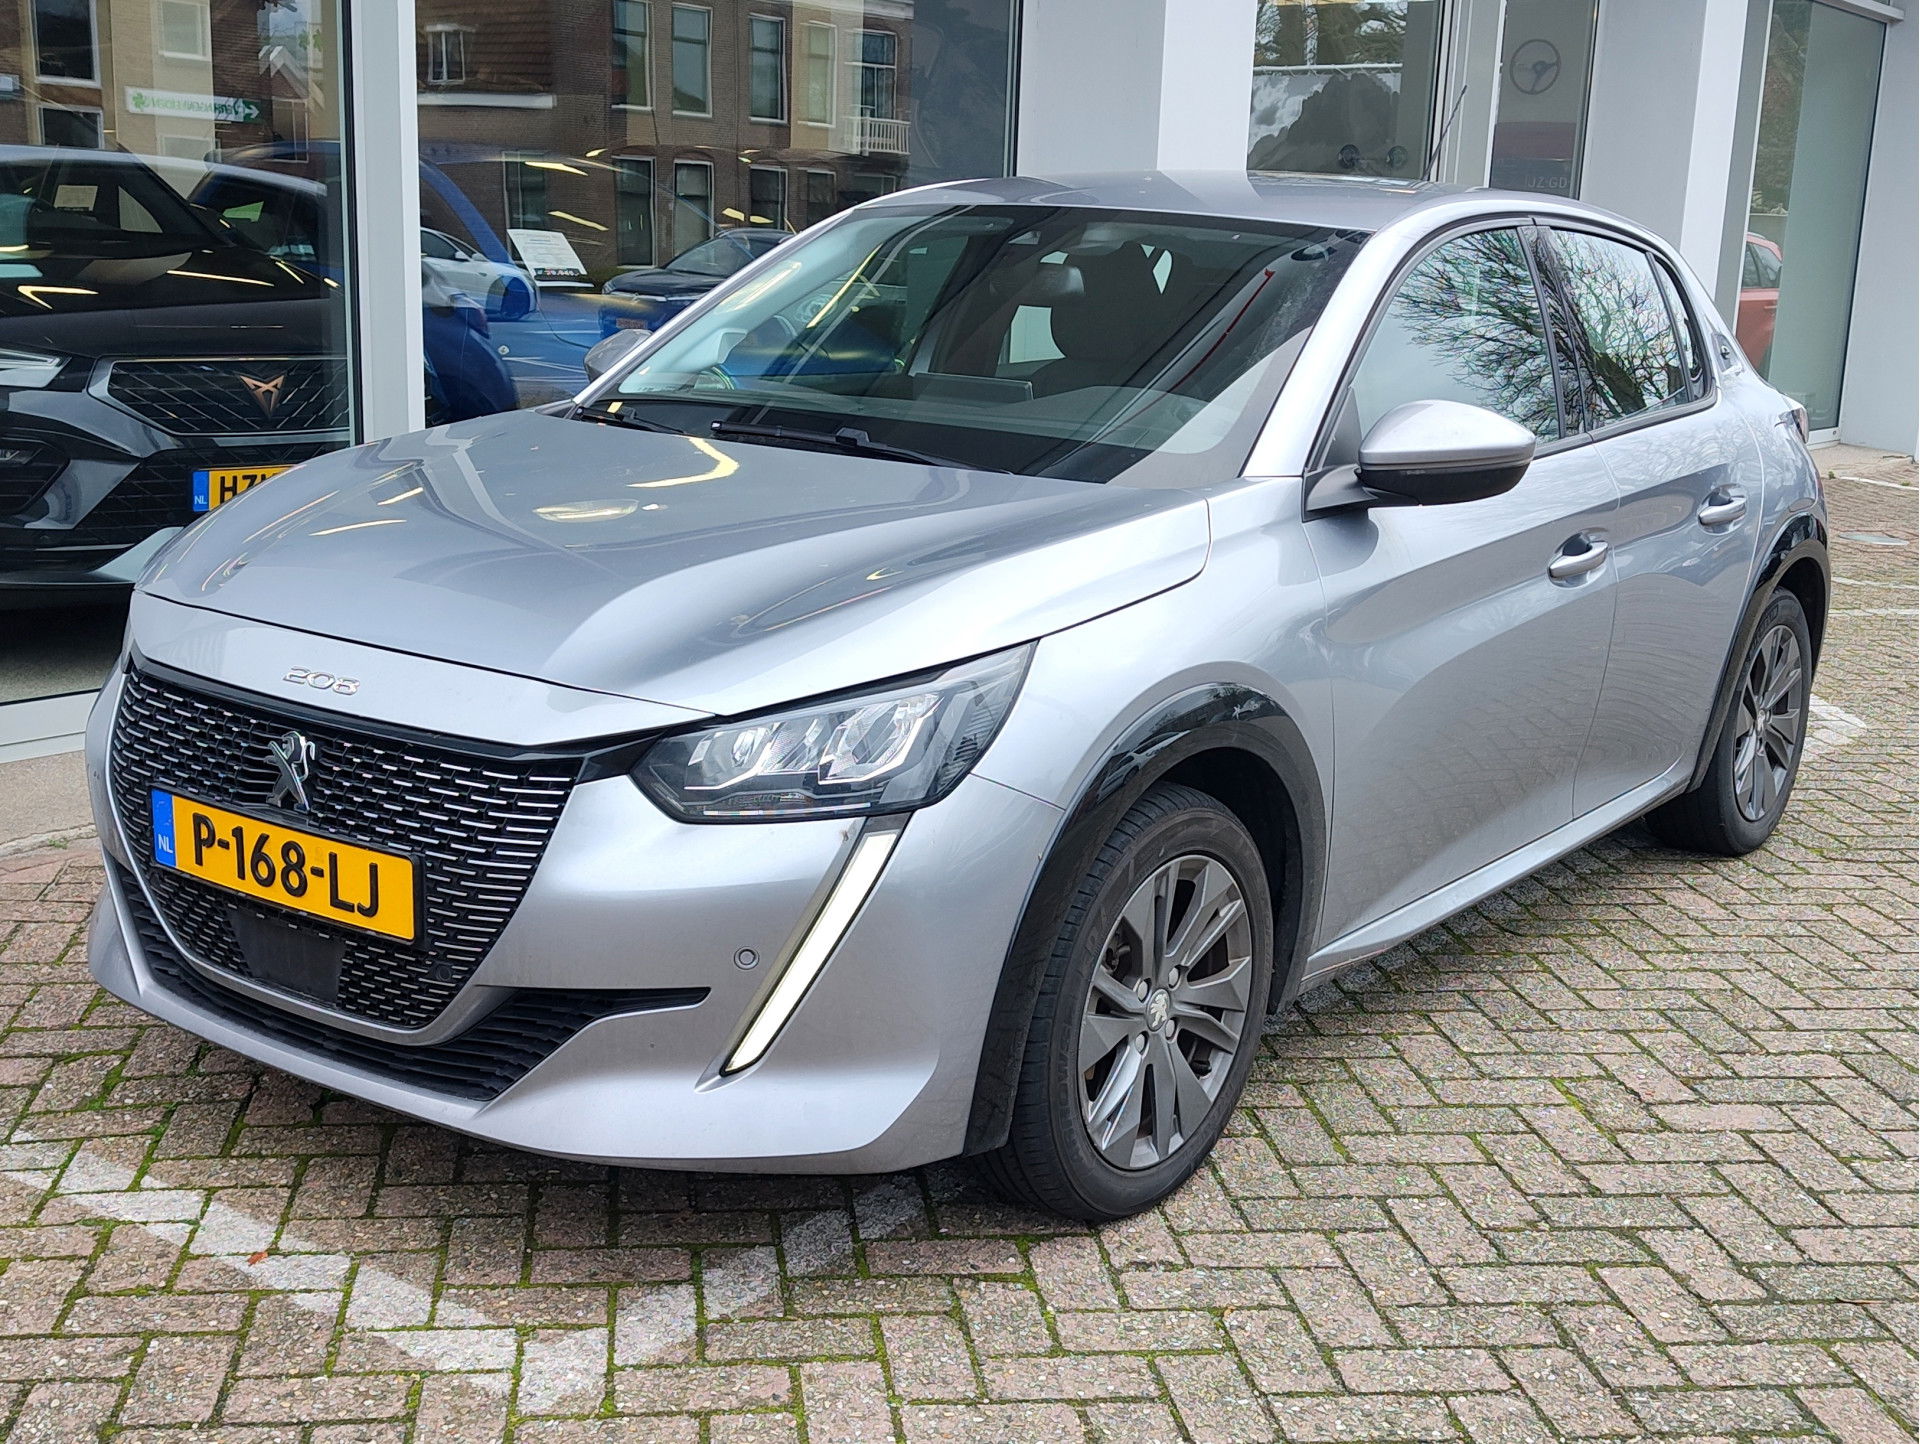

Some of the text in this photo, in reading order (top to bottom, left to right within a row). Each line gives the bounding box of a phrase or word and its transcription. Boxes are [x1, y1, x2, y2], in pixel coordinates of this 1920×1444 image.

[194, 495, 208, 505] NL
[283, 666, 360, 695] 208
[158, 833, 174, 854] NL
[192, 812, 379, 918] P-168-LJ
